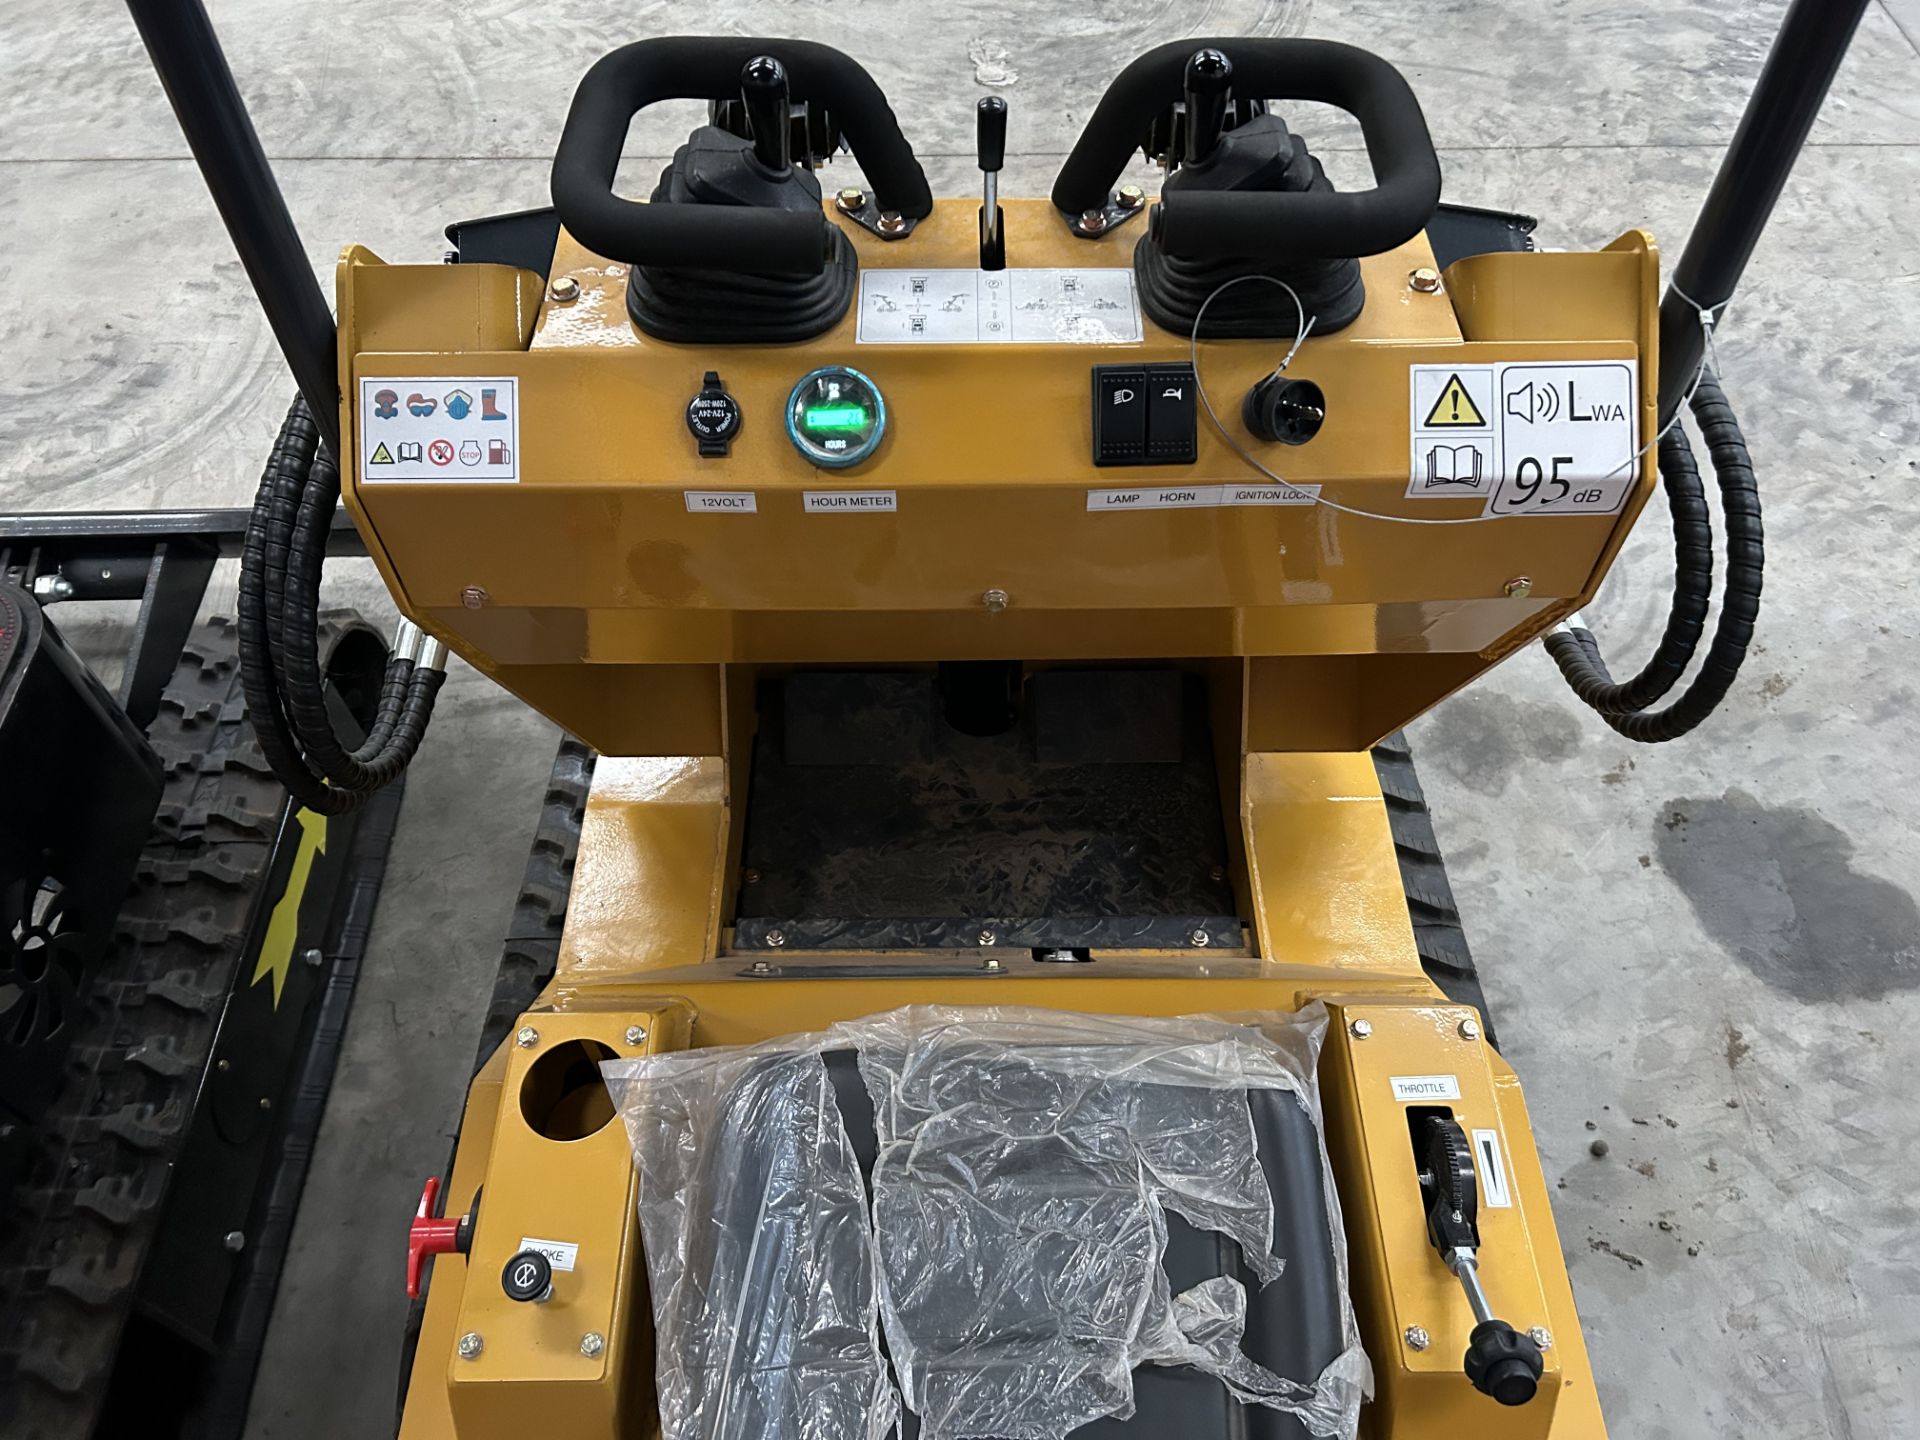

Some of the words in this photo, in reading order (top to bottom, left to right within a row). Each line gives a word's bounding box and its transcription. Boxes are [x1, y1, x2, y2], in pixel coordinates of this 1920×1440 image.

[698, 409, 725, 417] 12V-24V
[691, 414, 710, 433] OUTLET
[715, 412, 732, 433] POWER
[824, 439, 847, 449] HOURS
[461, 451, 479, 459] STOP
[1508, 456, 1573, 505] 95
[1573, 489, 1602, 503] dB
[1106, 494, 1140, 504] LAMP
[1159, 492, 1196, 502] HORN
[1235, 490, 1281, 500] IGNITION
[701, 498, 747, 507] 12VOLT
[811, 497, 847, 507] HOUR
[850, 497, 892, 506] METER
[1398, 1083, 1446, 1094] THROTTLE
